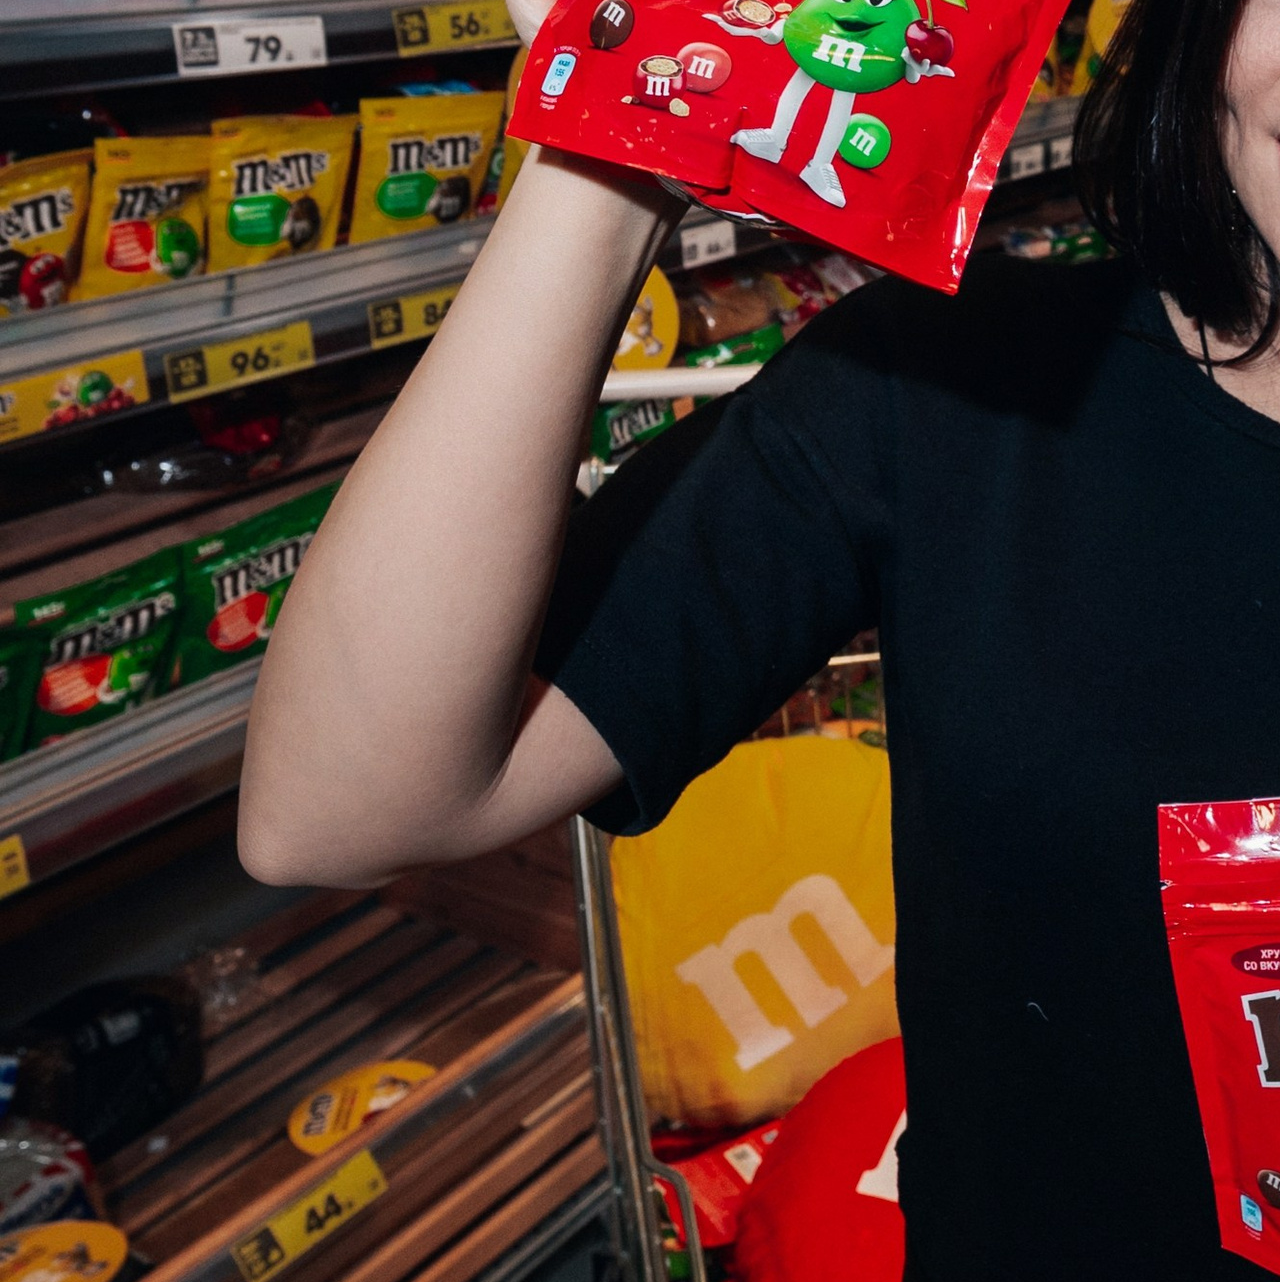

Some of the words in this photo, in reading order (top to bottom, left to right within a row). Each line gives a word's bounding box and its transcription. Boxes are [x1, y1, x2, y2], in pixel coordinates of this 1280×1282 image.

[245, 35, 283, 64] 79
[230, 346, 271, 377] 96
[675, 873, 896, 1073] m
[1243, 961, 1257, 971] СО
